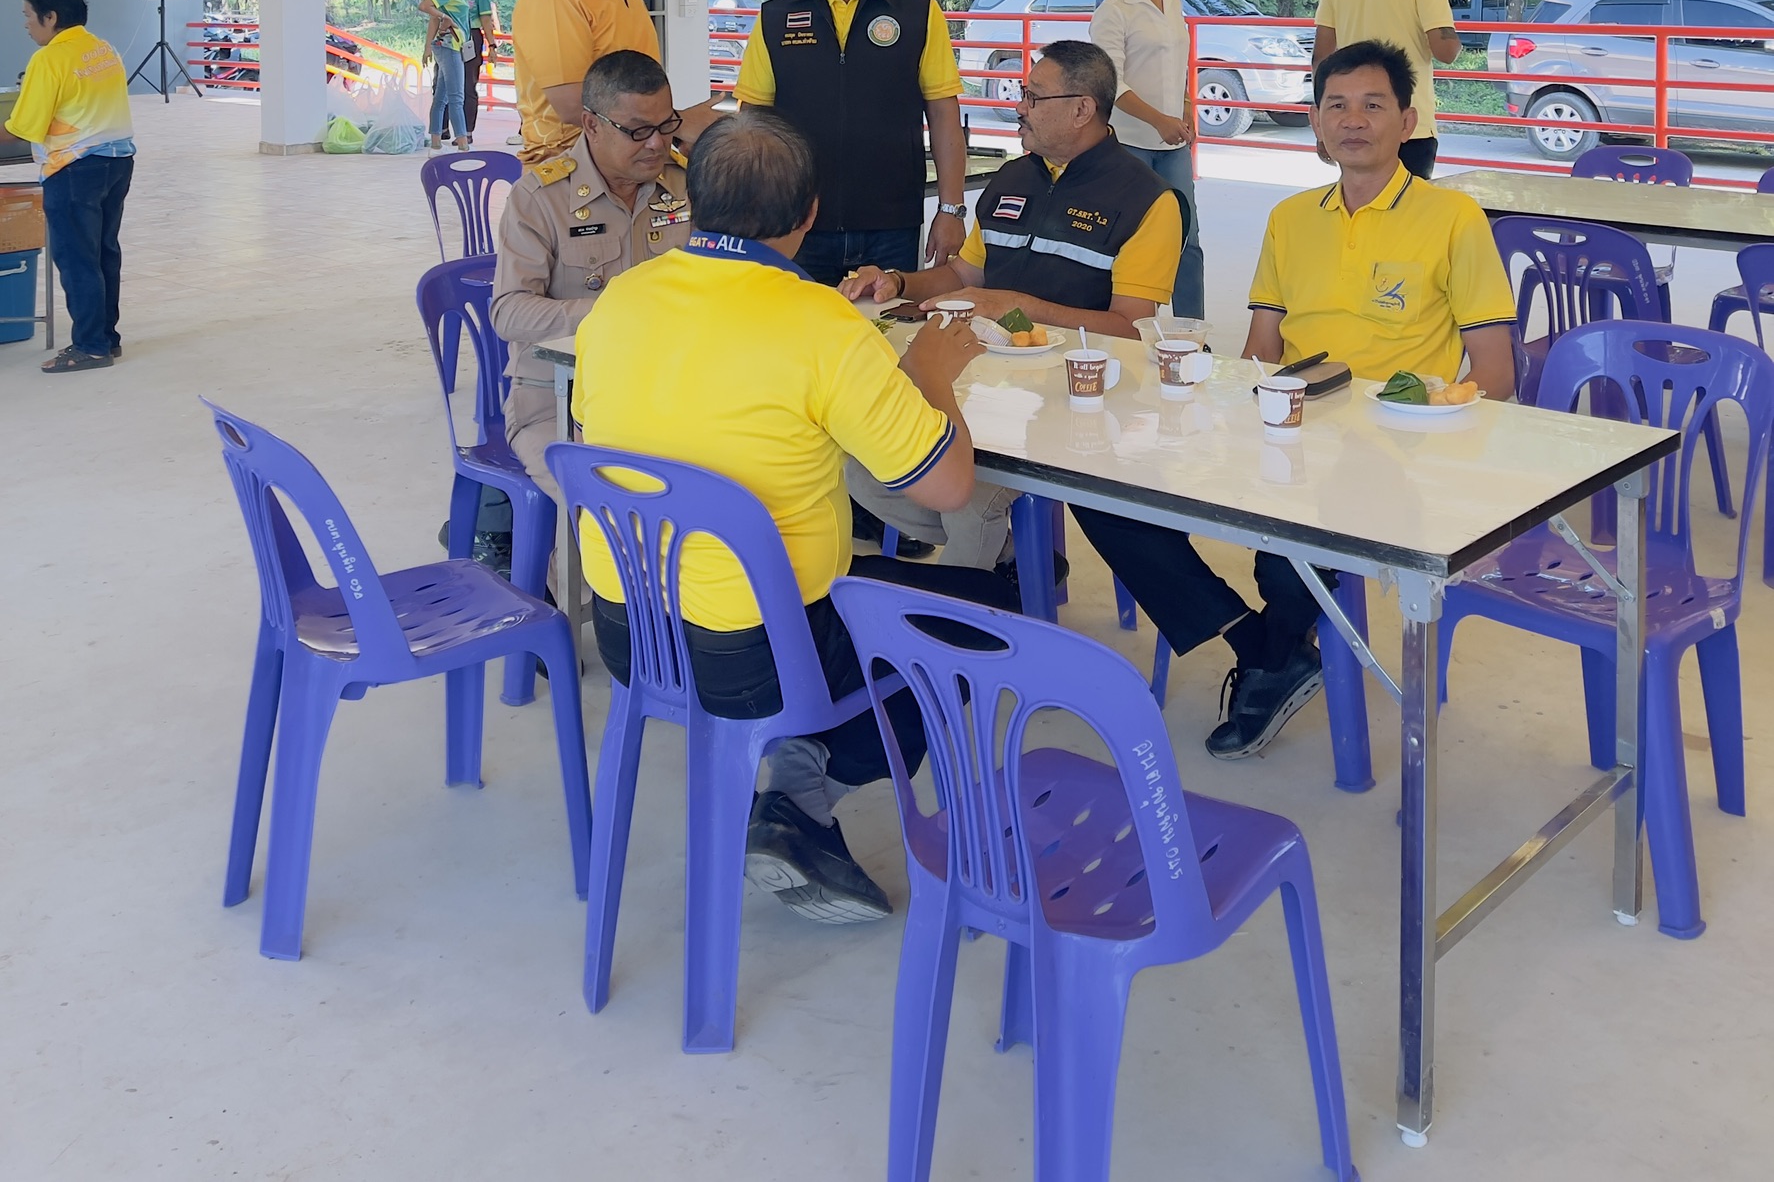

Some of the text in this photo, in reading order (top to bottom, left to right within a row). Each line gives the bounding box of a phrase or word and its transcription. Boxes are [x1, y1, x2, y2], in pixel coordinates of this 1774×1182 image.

[1071, 220, 1093, 232] 2020
[716, 234, 747, 254] ALL
[1165, 847, 1184, 880] 045
